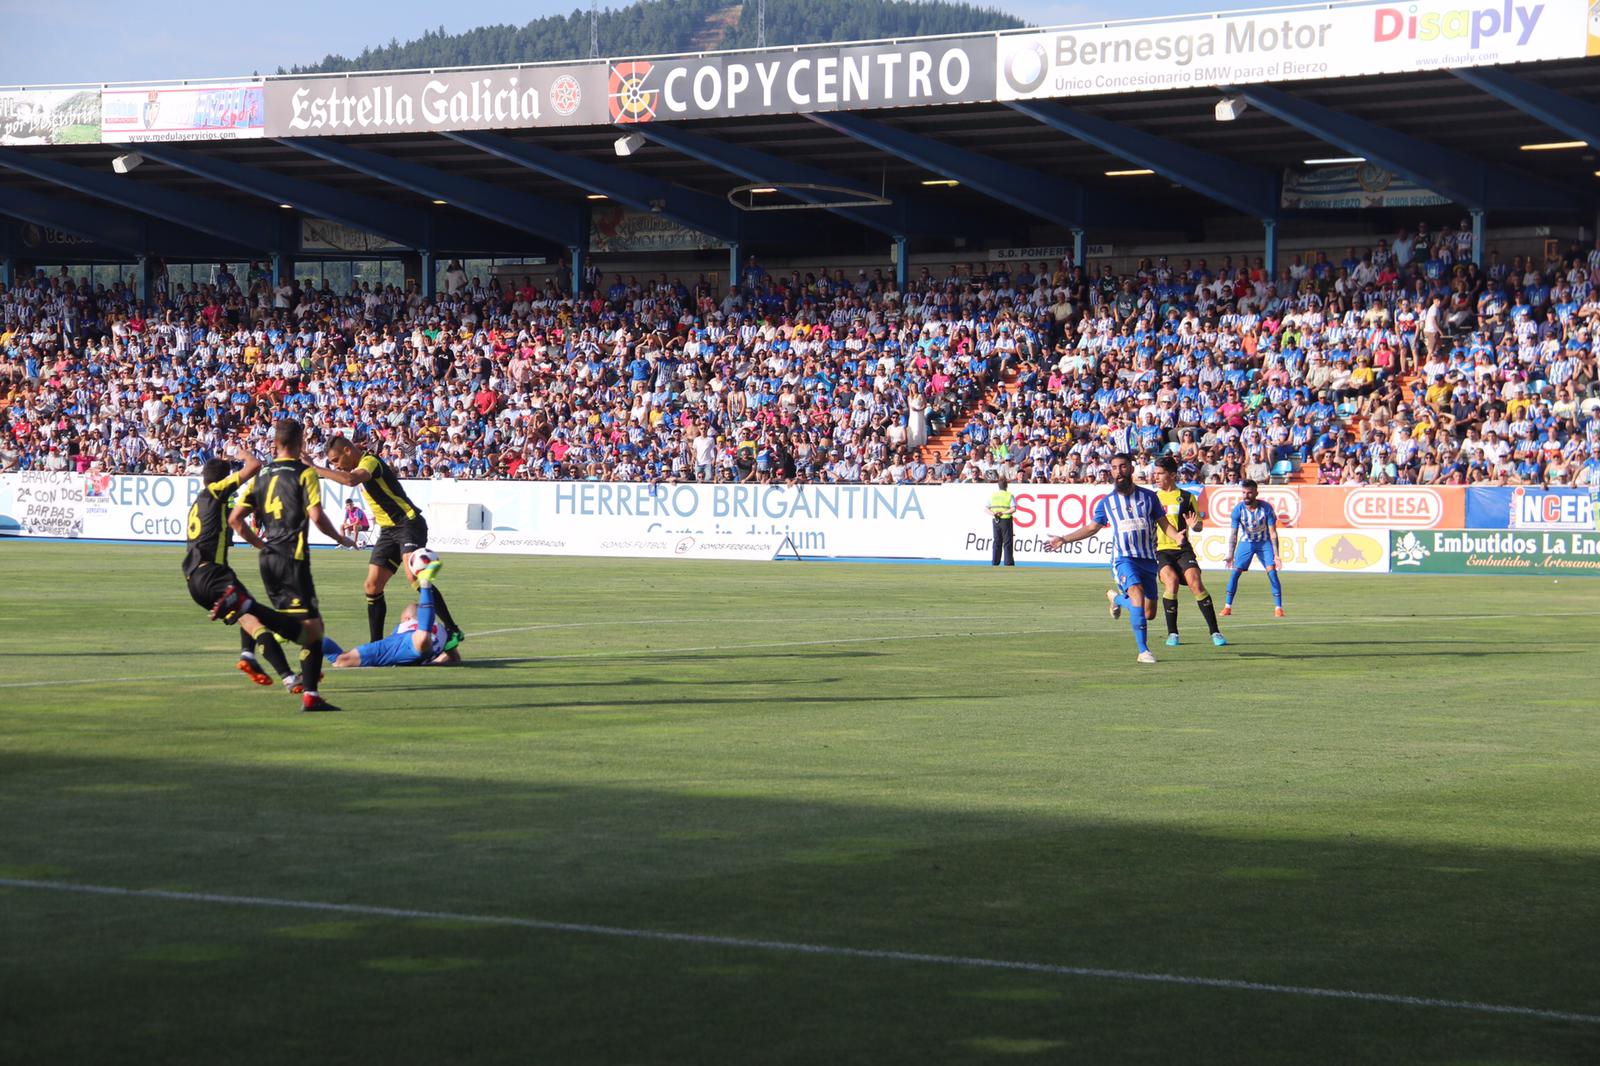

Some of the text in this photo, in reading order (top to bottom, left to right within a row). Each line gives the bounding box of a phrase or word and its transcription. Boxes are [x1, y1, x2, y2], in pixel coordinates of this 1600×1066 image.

[1374, 0, 1544, 49] Disaply
[1055, 20, 1332, 67] Bernesga Motor
[664, 48, 970, 112] COPYCENTRO
[1095, 72, 1191, 88] Concesionario
[1194, 66, 1232, 82] BMW
[1234, 67, 1266, 80] para
[1268, 63, 1280, 76] el
[1284, 61, 1328, 75] Bierzo
[289, 86, 414, 129] Estrella
[421, 77, 541, 124] Galicia
[128, 131, 237, 142] www.medulaservicios.com
[1020, 247, 1104, 258] PONFERNA
[34, 489, 57, 503] CON
[61, 488, 83, 502] DOS
[264, 475, 283, 519] 4
[556, 484, 699, 518] HERRERO
[713, 486, 925, 519] BRIGANTINA
[1353, 497, 1430, 519] CERIESA
[26, 503, 75, 519] BARBAS
[130, 511, 182, 535] Certo
[188, 503, 201, 540] 6
[966, 533, 992, 551] Par
[1087, 536, 1113, 554] Cre
[1434, 532, 1537, 554] Embutidos
[1543, 533, 1566, 554] La
[1466, 555, 1531, 567] Embutidos
